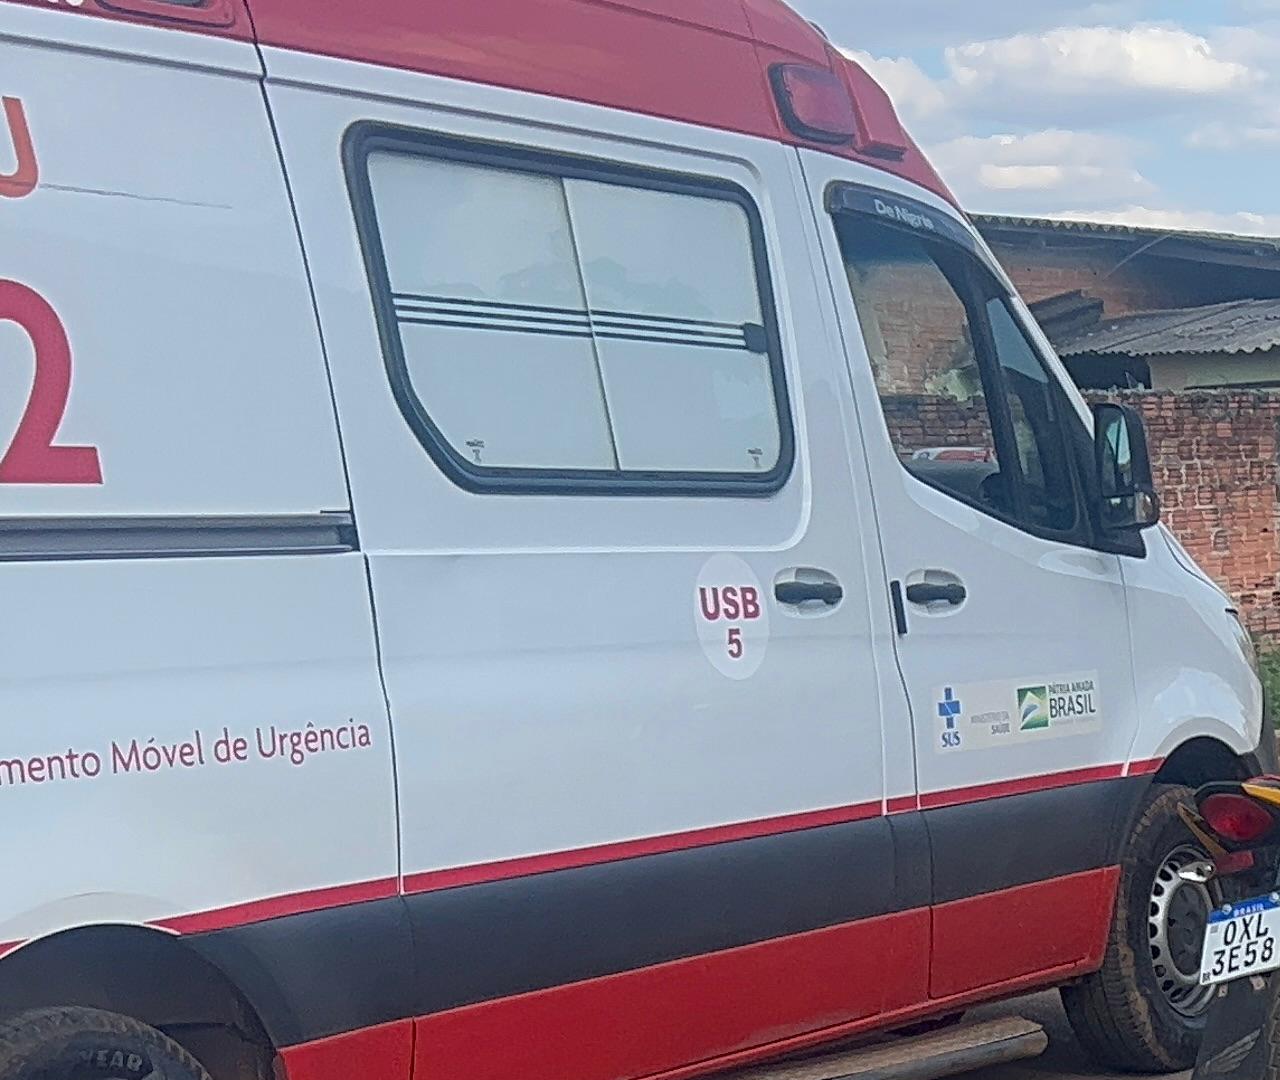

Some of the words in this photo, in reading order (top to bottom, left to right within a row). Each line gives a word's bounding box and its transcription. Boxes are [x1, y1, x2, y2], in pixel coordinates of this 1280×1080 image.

[699, 586, 761, 621] USB
[727, 628, 743, 659] 5
[1050, 694, 1096, 718] BRASIL
[112, 729, 205, 774] Móvel
[214, 727, 248, 763] de
[256, 719, 372, 766] Urgência
[1223, 914, 1269, 946] OXL
[1212, 937, 1275, 976] 3E58
